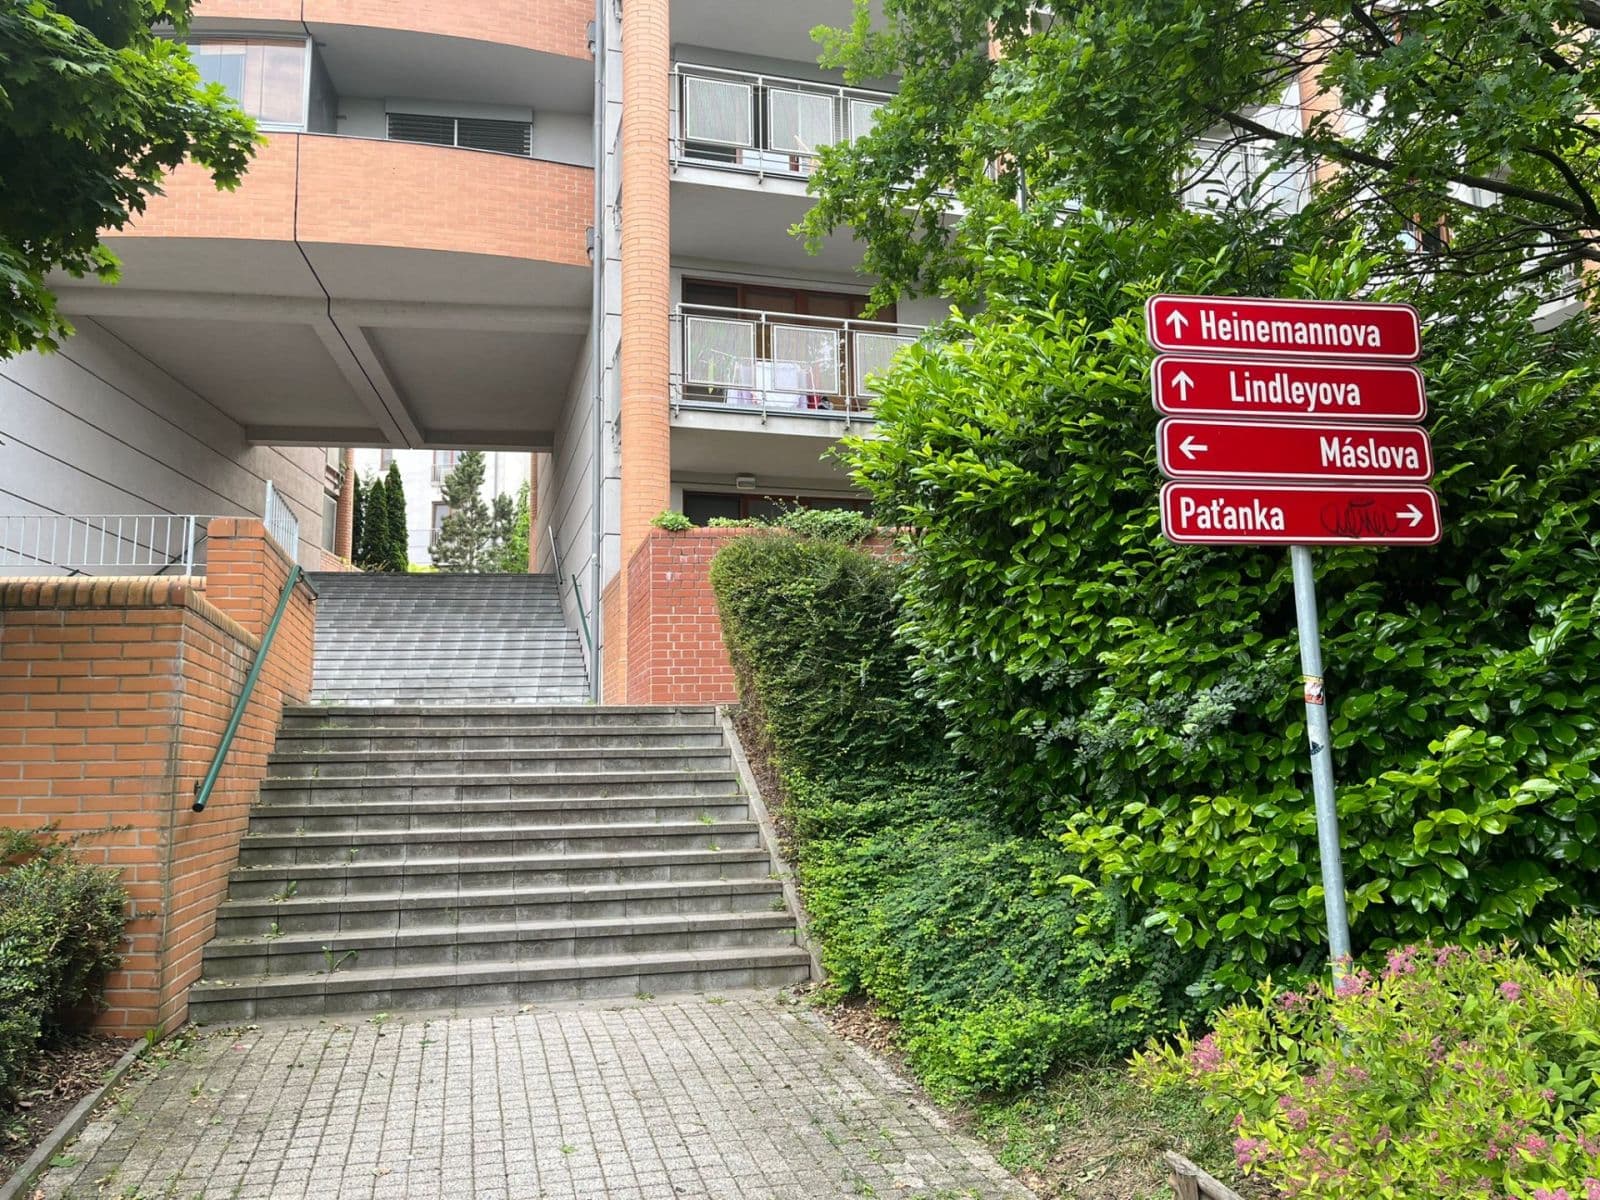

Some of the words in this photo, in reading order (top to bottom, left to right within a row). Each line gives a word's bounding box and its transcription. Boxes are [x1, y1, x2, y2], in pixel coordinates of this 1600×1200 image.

[1200, 310, 1381, 347] Heinemannova
[1229, 370, 1361, 412] Lindleyova
[1319, 436, 1419, 469] Máslova
[1179, 496, 1285, 531] Paťanka
